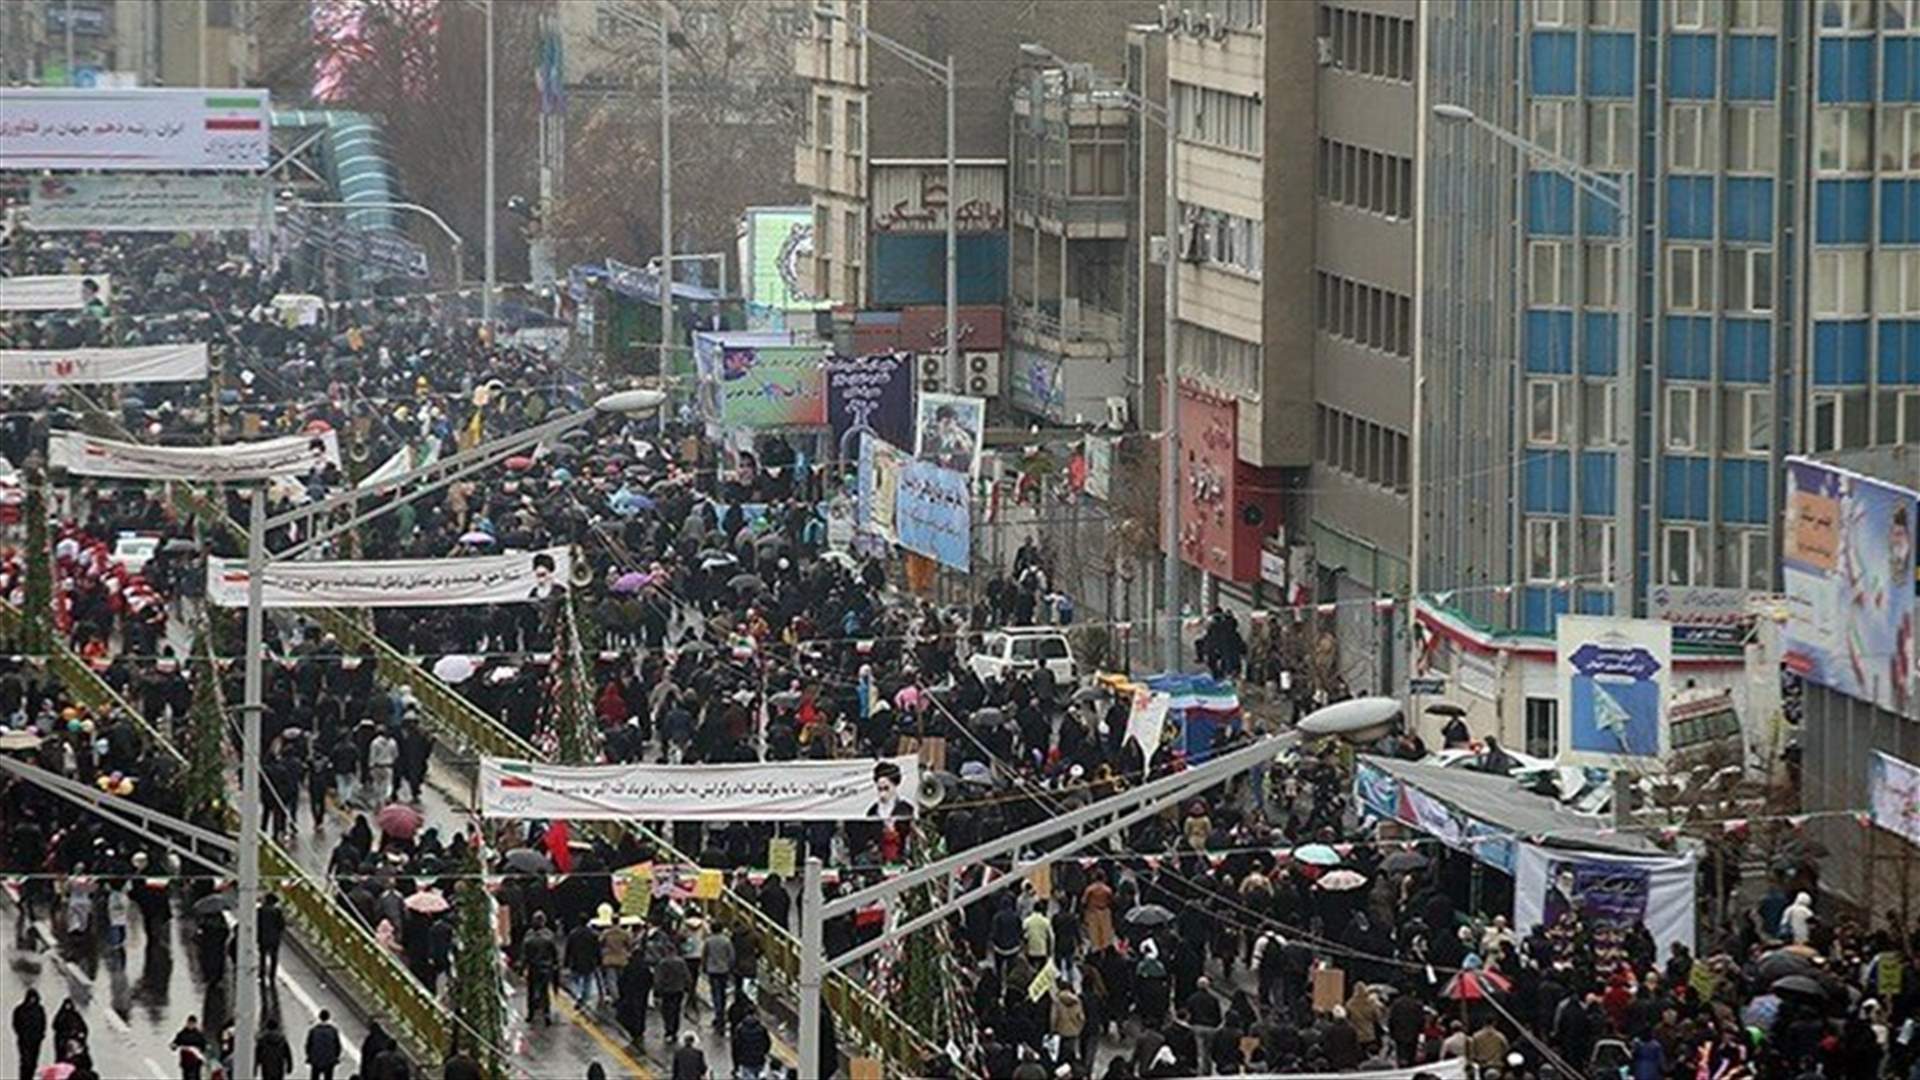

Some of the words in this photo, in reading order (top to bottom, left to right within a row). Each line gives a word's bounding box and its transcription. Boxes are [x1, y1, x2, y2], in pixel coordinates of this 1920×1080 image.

[56, 118, 89, 137] جهان
[875, 197, 936, 230] مسکن
[956, 197, 1001, 229] بانک
